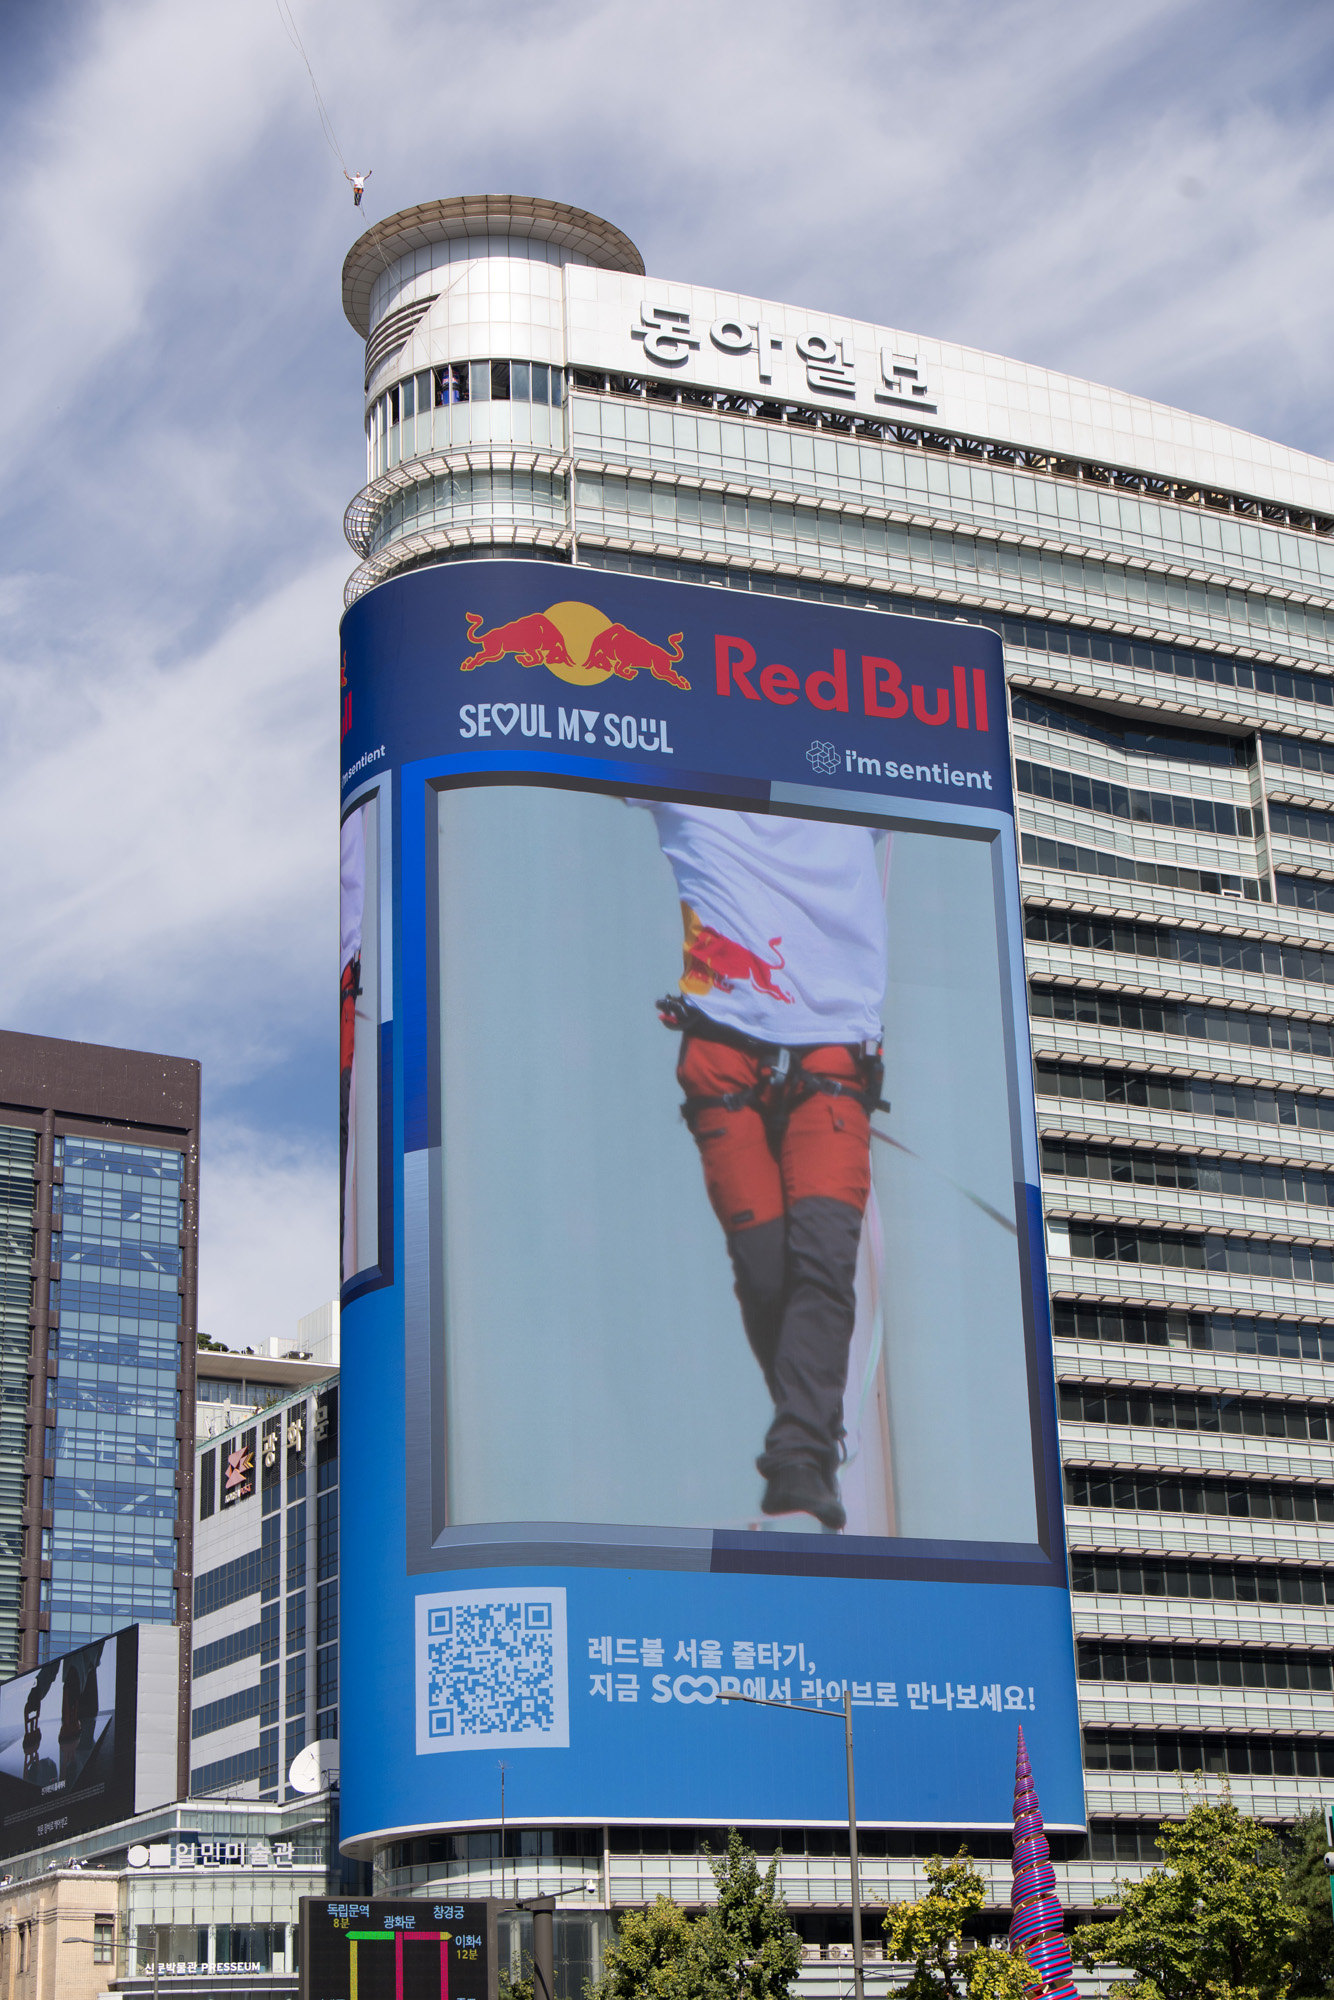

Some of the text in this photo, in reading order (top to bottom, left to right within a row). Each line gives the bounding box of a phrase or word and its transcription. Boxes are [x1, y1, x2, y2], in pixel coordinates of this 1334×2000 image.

[630, 300, 939, 413] 동아일보
[714, 634, 988, 732] Red Bull
[603, 713, 674, 754] SOUL
[348, 745, 386, 779] sentient
[845, 750, 993, 791] i'm sentient
[588, 1636, 816, 1675] 레드불 서울 줄타기,
[589, 1672, 640, 1702] 지금
[801, 1678, 899, 1708] 라이브로
[906, 1682, 1035, 1712] 만나보세요!
[176, 1842, 295, 1868] 일민미술관
[327, 1903, 370, 1918] 독립문역
[333, 1917, 350, 1928] 8분
[383, 1915, 416, 1929] 광화문
[433, 1905, 465, 1919] 창경궁
[455, 1935, 482, 1949] 이화4
[456, 1949, 479, 1960] 12분
[201, 1961, 260, 1974] PRESSEUM
